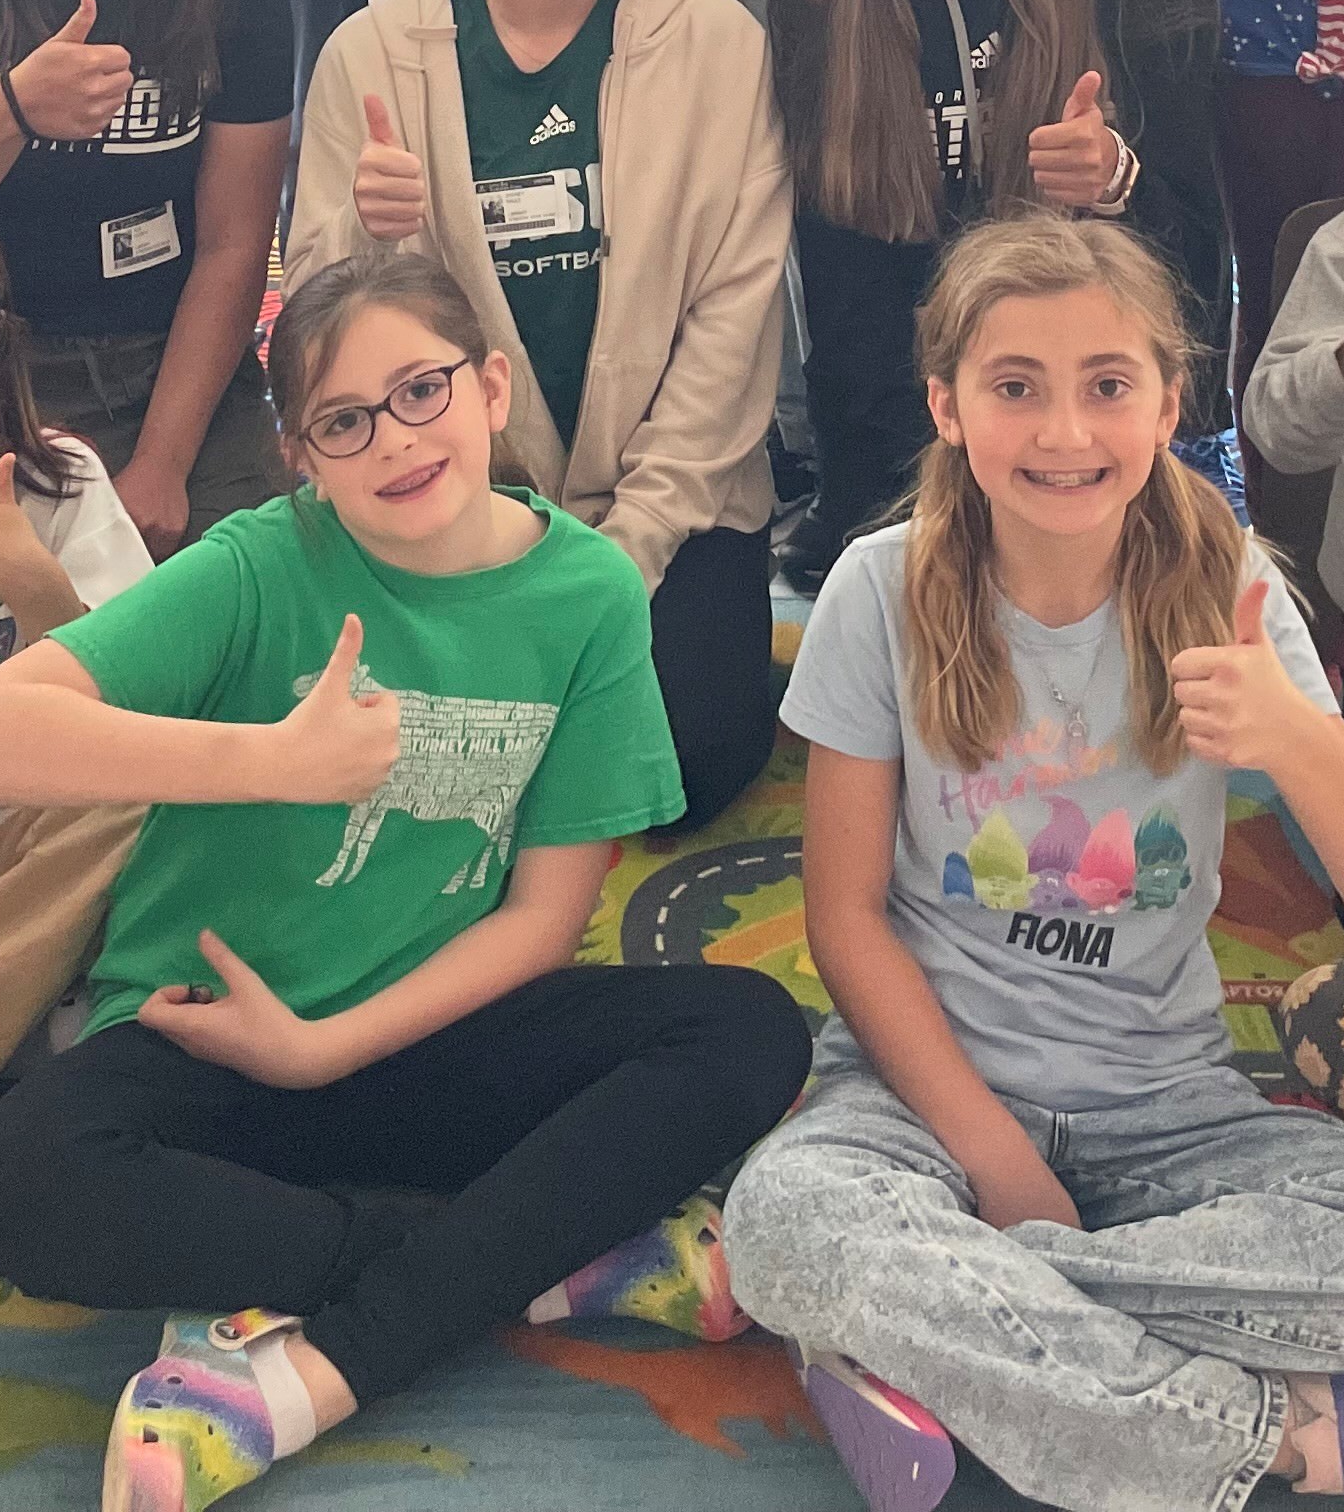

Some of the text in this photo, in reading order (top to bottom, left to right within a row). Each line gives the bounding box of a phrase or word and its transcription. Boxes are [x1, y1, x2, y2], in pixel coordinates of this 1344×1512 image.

[529, 120, 576, 145] adidas
[413, 738, 467, 753] TURKEY
[469, 738, 501, 753] HILL
[1006, 911, 1115, 968] FIONA
